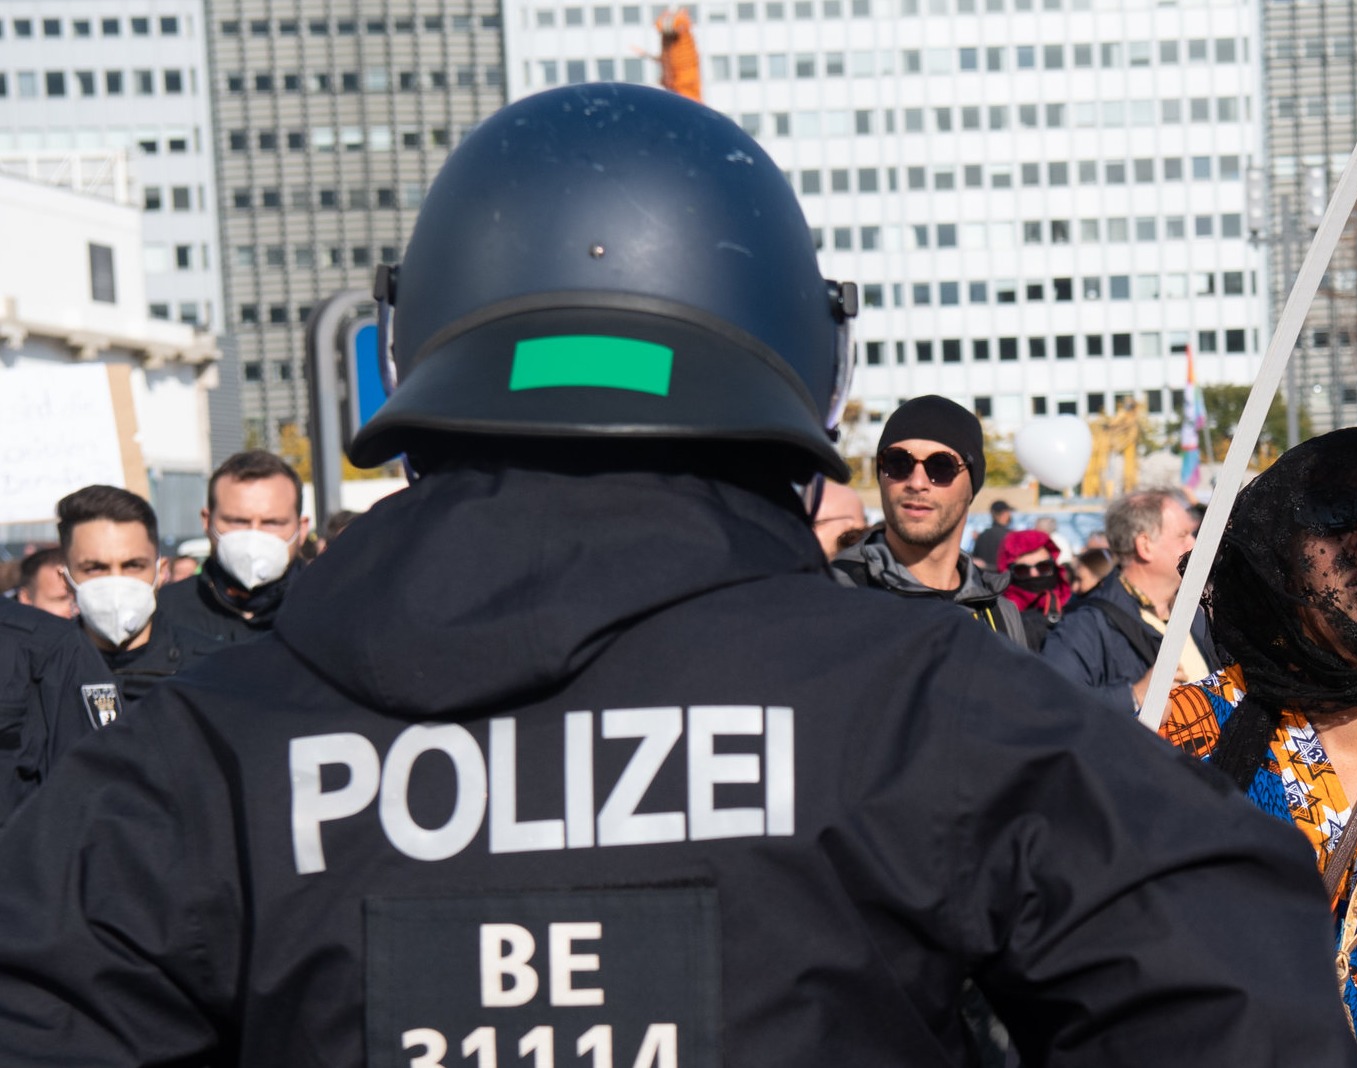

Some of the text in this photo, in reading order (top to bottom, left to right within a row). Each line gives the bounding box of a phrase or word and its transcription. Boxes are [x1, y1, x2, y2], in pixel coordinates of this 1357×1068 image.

[289, 705, 795, 876] POLIZEI
[480, 922, 604, 1008] BE
[401, 1023, 678, 1068] 31114
